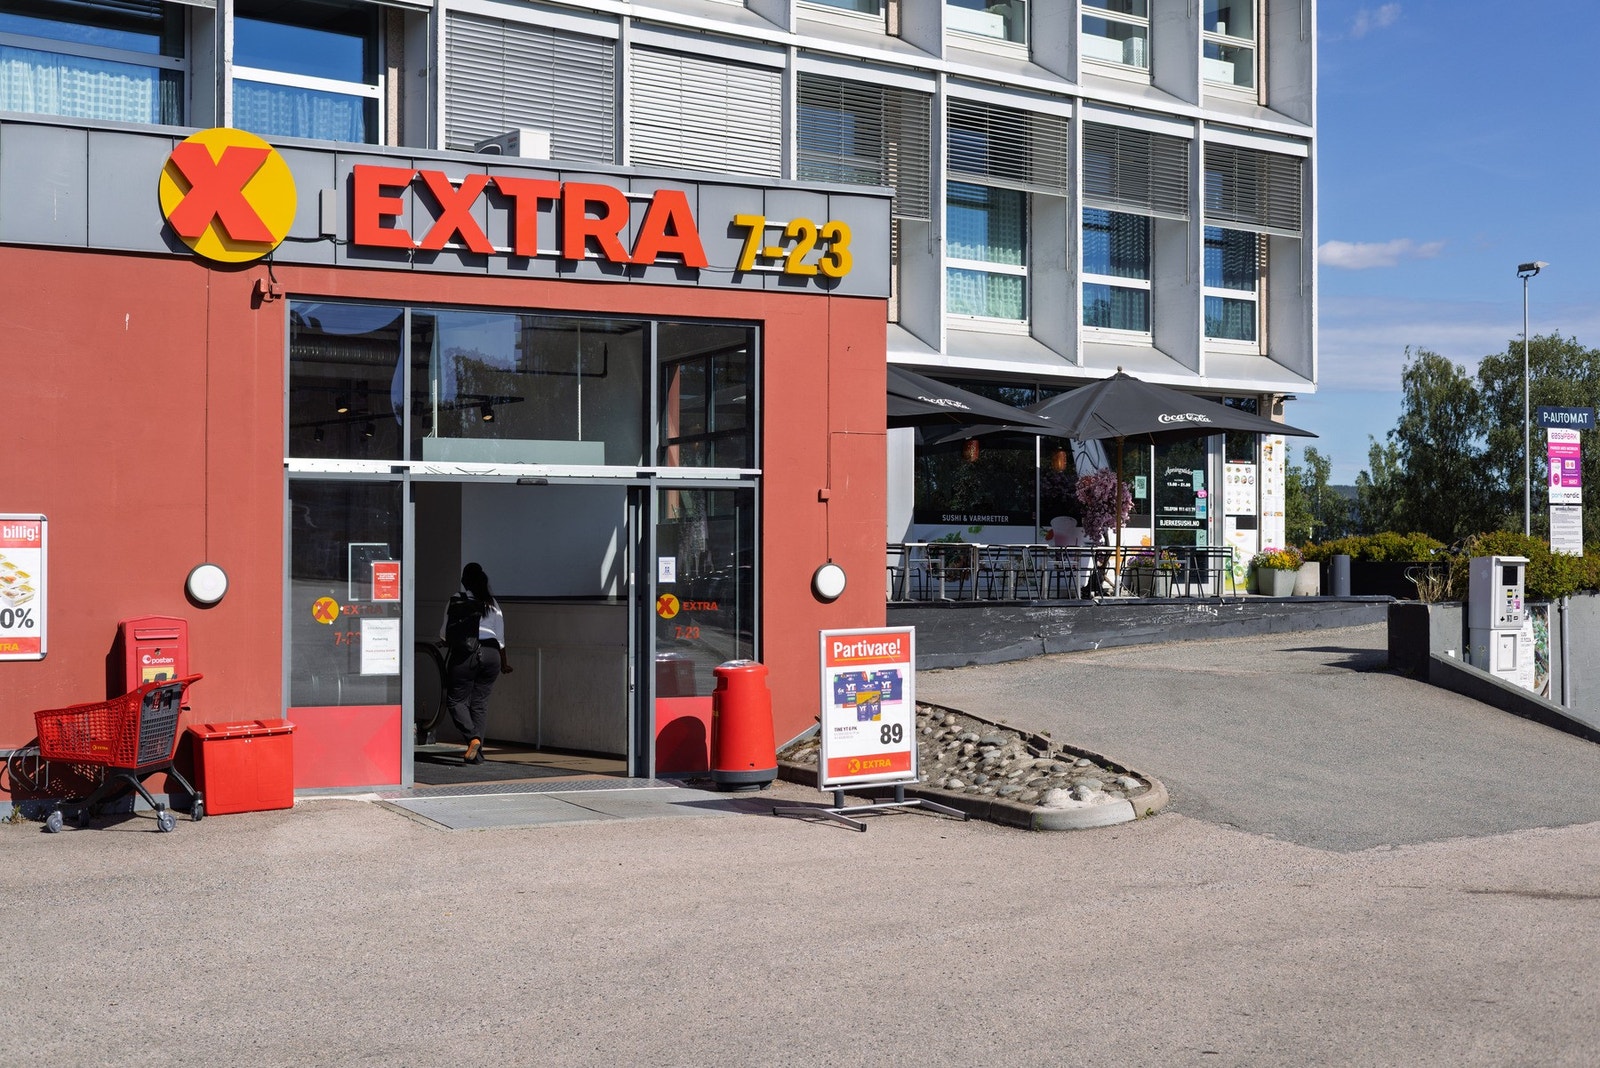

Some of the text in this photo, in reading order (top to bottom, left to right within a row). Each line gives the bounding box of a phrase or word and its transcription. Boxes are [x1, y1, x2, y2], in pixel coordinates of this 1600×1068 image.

[353, 164, 708, 268] EXTRA
[733, 214, 853, 278] 7-23
[1158, 413, 1212, 424] Coca-Cola
[1543, 412, 1589, 424] P-AUTOMAT
[942, 514, 962, 522] SUSHI
[3, 525, 39, 541] billig!
[683, 601, 719, 611] EXTRA
[675, 627, 700, 639] 7-23
[833, 638, 901, 659] Partivare!
[151, 657, 175, 665] posten
[880, 723, 903, 744] 89
[862, 759, 892, 769] EXTRA
